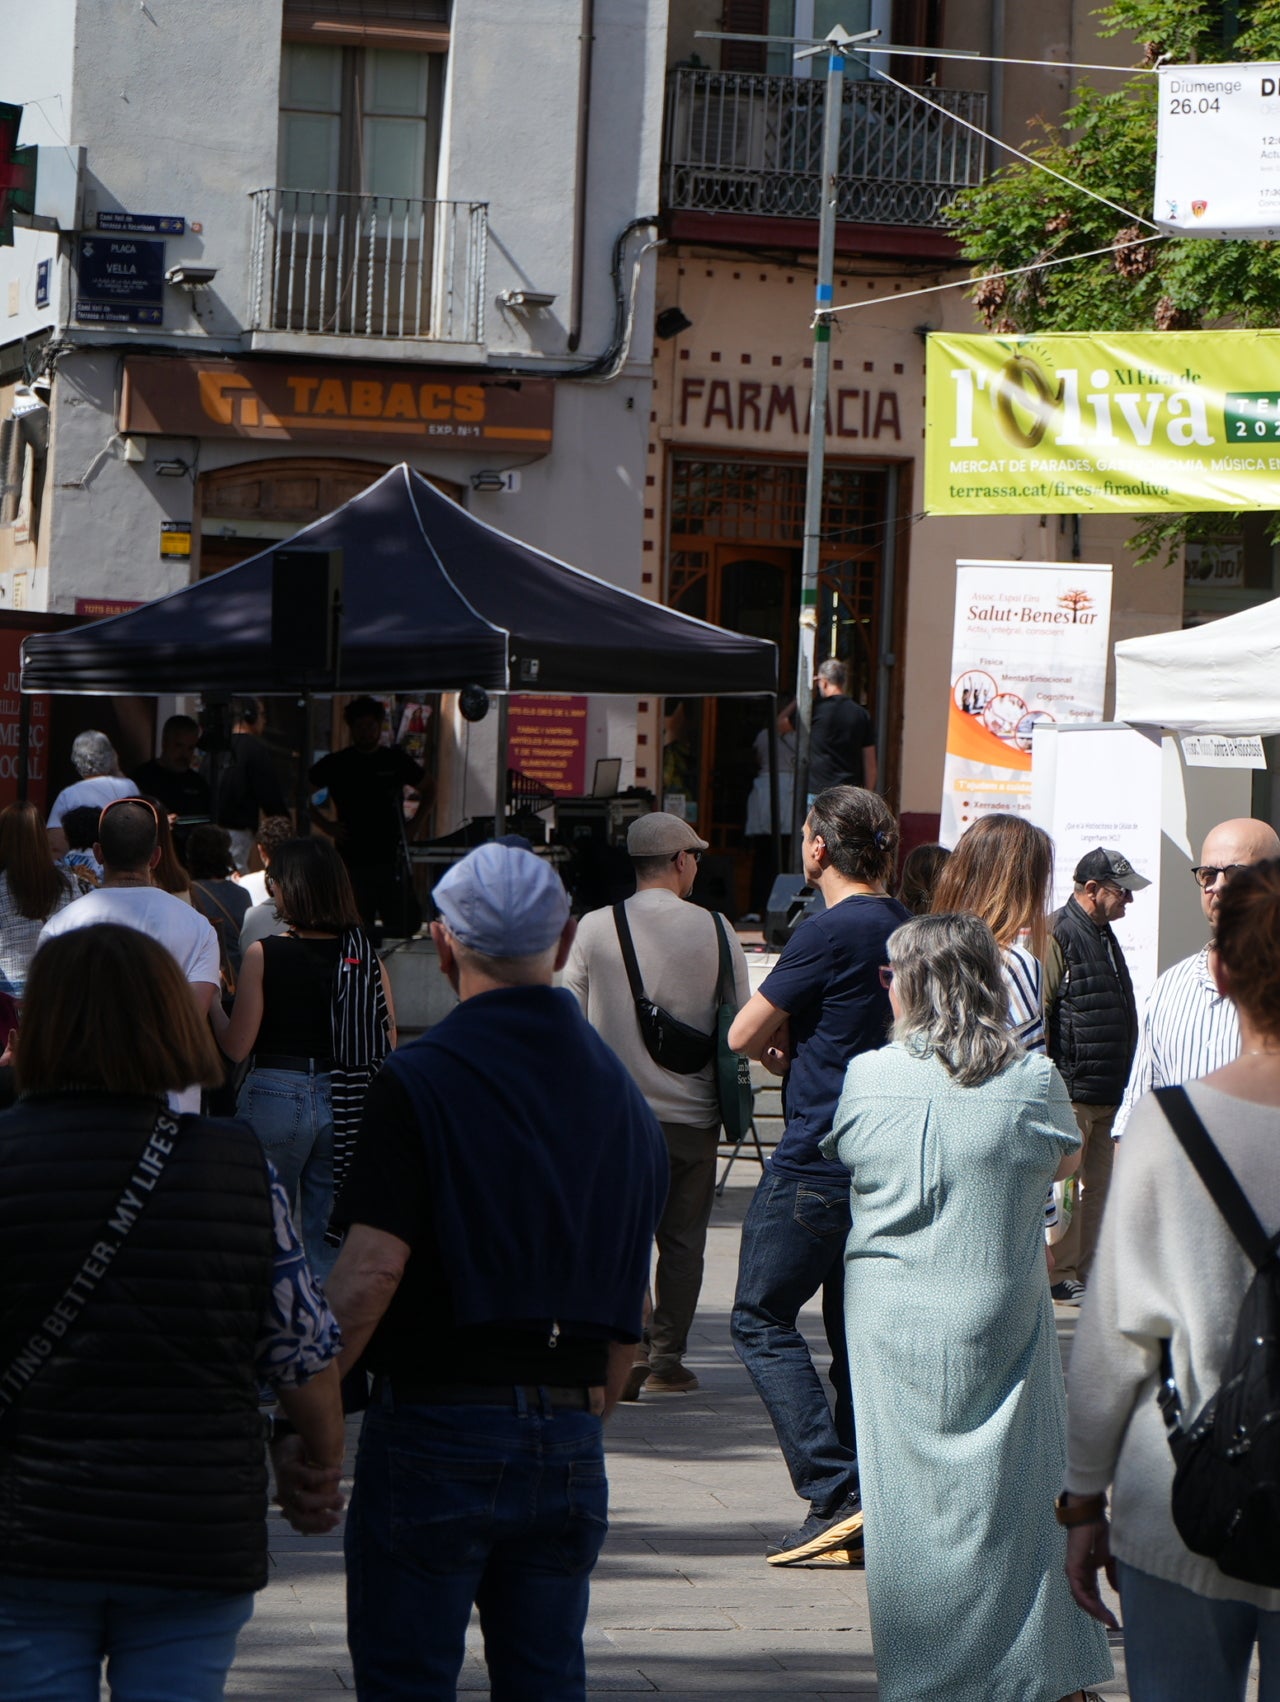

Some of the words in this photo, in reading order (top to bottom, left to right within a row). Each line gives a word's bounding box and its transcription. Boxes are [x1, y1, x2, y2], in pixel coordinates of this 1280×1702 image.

[1170, 80, 1242, 95] Diumenge
[1170, 97, 1221, 115] 26.04
[106, 263, 137, 275] VELLA
[1179, 367, 1202, 385] de
[287, 377, 487, 423] TABACS
[950, 461, 1005, 474] MERCAT
[1009, 460, 1027, 473] DE
[1030, 458, 1094, 474] PARADES,
[1211, 454, 1266, 472] MÚSICA
[973, 801, 1011, 811] Xerrades
[42, 1240, 122, 1338] BETTER.
[108, 1188, 144, 1234] MY
